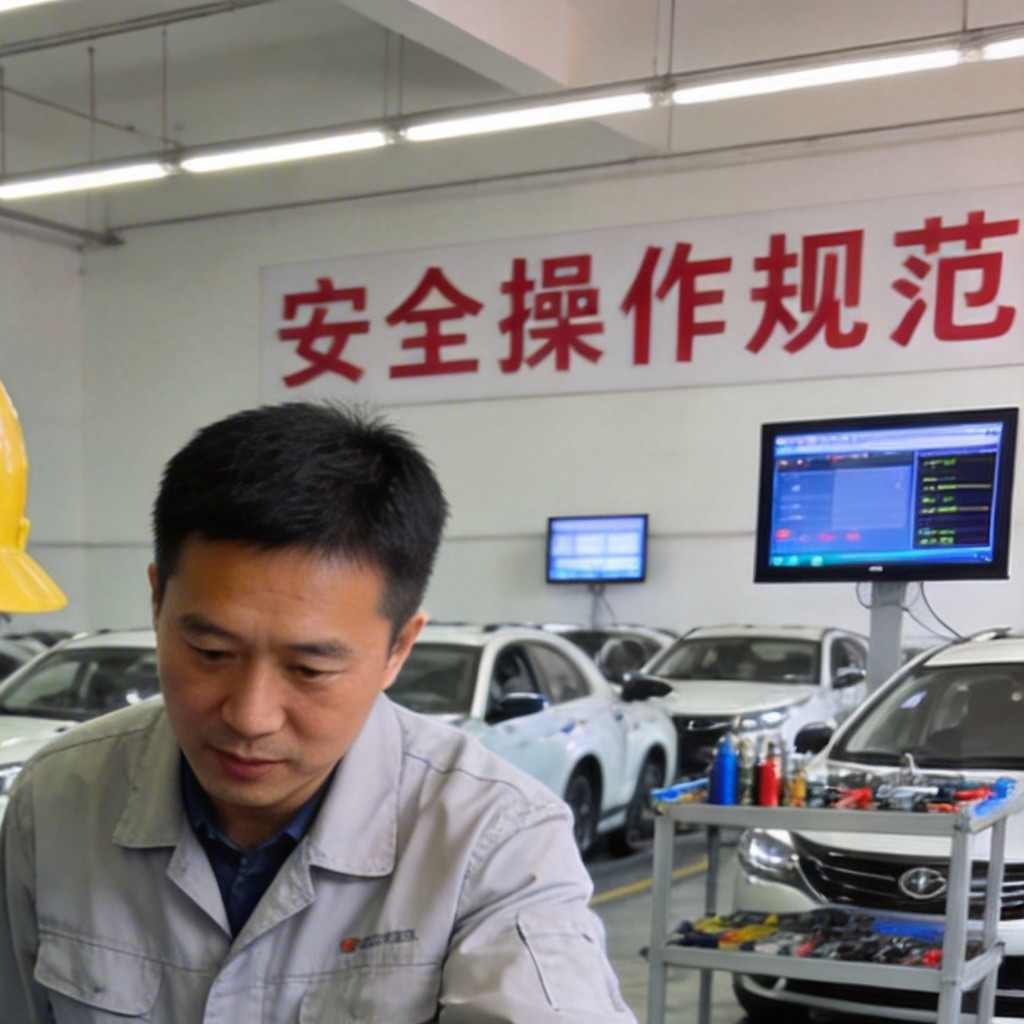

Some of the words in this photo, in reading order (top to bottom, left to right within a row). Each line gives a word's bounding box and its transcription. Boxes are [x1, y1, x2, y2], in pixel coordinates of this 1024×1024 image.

[279, 210, 1021, 386] 安全操作规范
